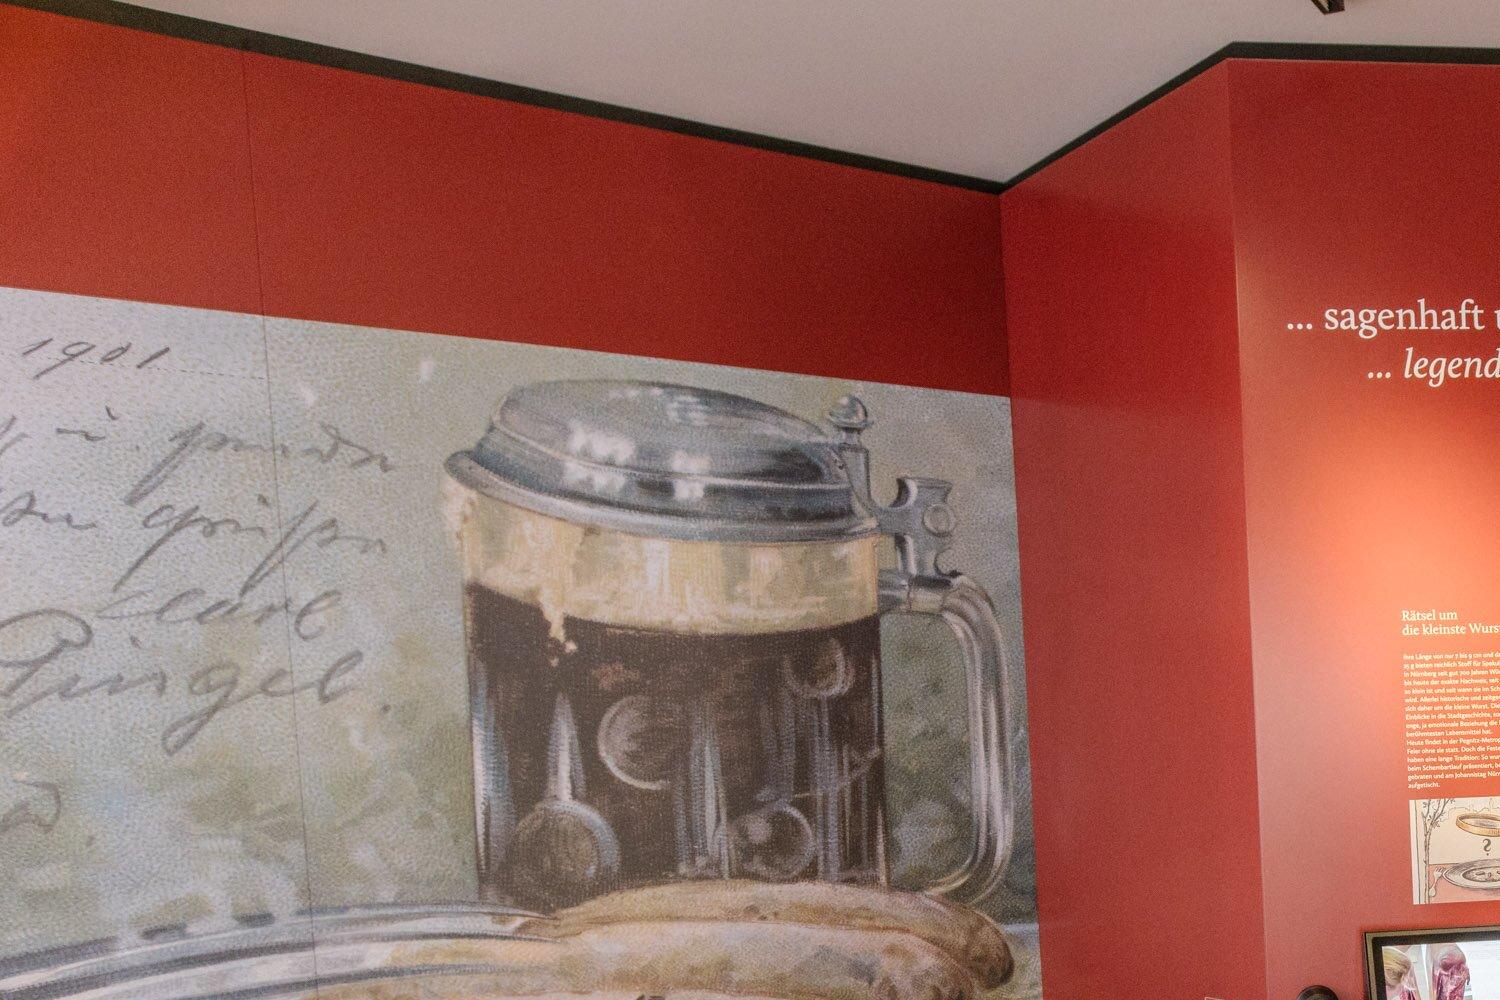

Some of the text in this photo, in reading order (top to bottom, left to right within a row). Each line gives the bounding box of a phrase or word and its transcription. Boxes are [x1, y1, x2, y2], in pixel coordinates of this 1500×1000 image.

[1324, 298, 1485, 340] sagenhaft
[22, 337, 171, 379] 1901
[1402, 609, 1458, 622] Rätsel um
[1402, 625, 1420, 636] die
[1422, 624, 1466, 635] kleinste
